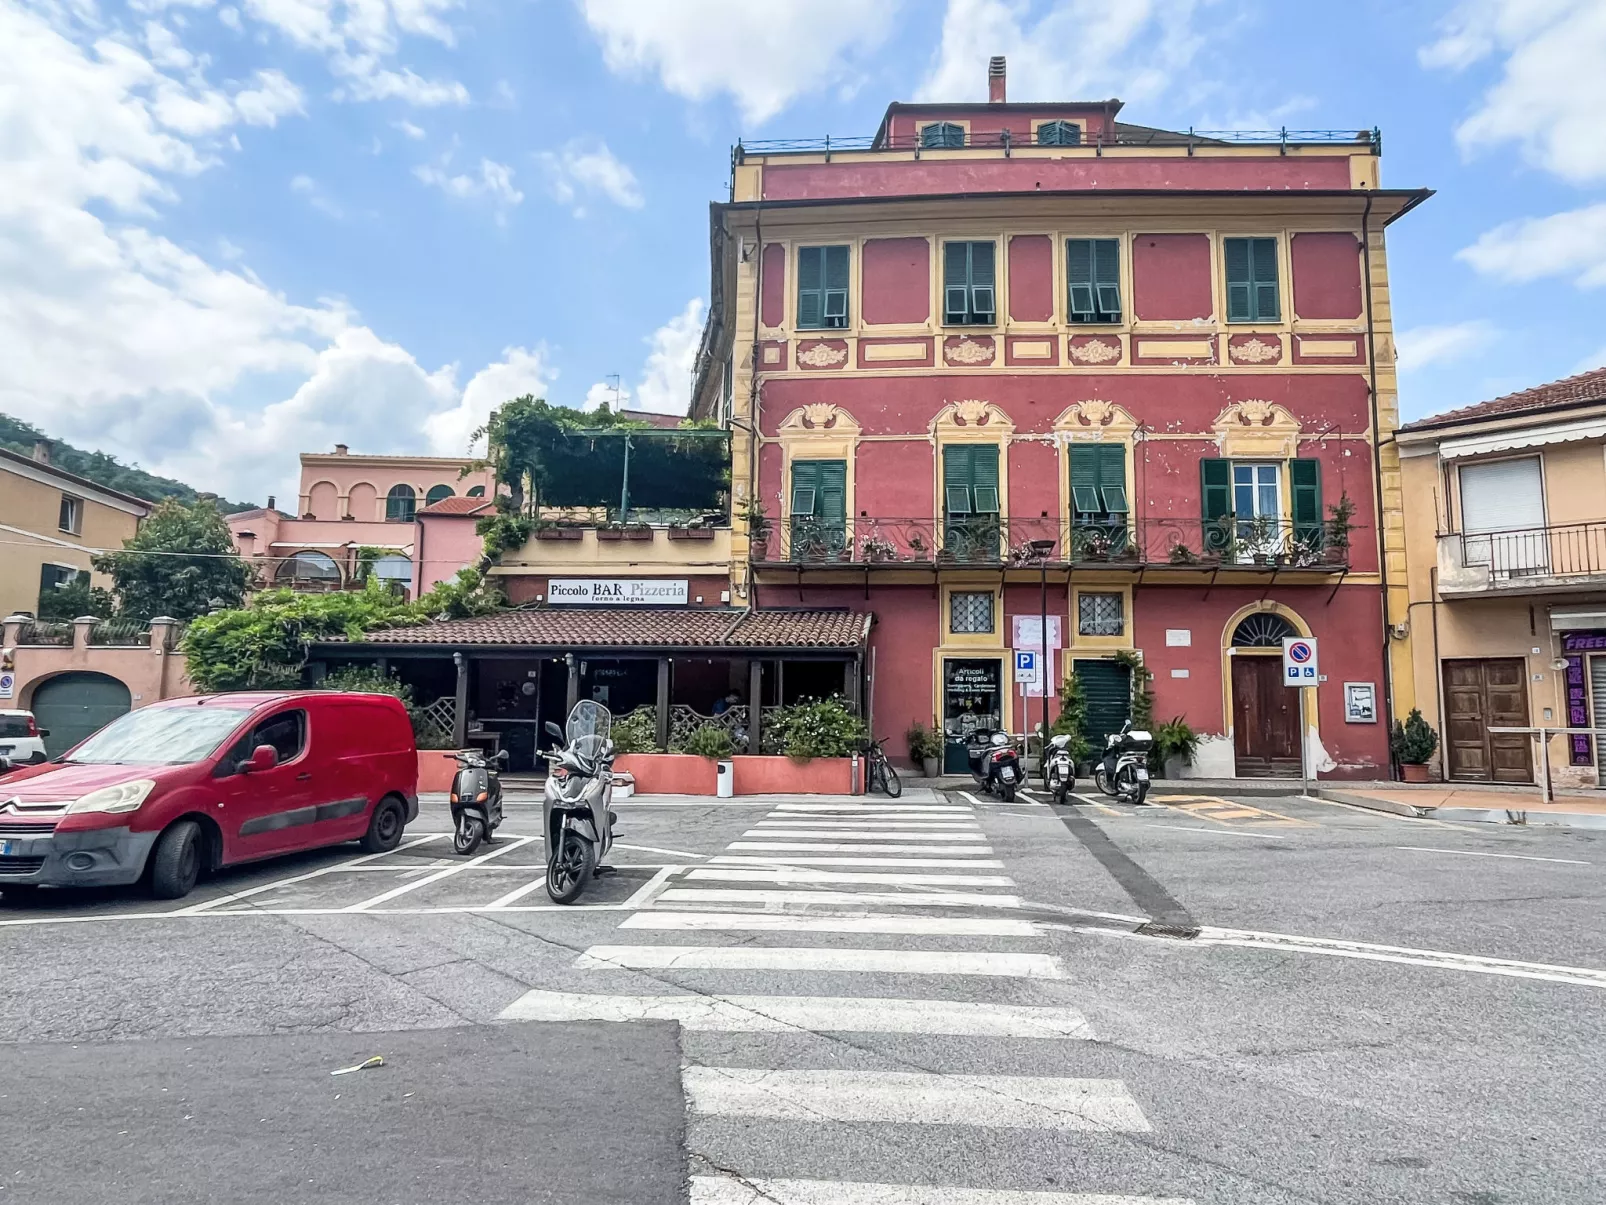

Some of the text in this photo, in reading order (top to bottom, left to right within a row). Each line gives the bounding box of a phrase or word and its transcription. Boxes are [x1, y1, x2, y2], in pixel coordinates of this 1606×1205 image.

[551, 583, 685, 596] Piccolo BAR Pizzeria
[1020, 655, 1030, 668] P
[1290, 668, 1297, 676] P
